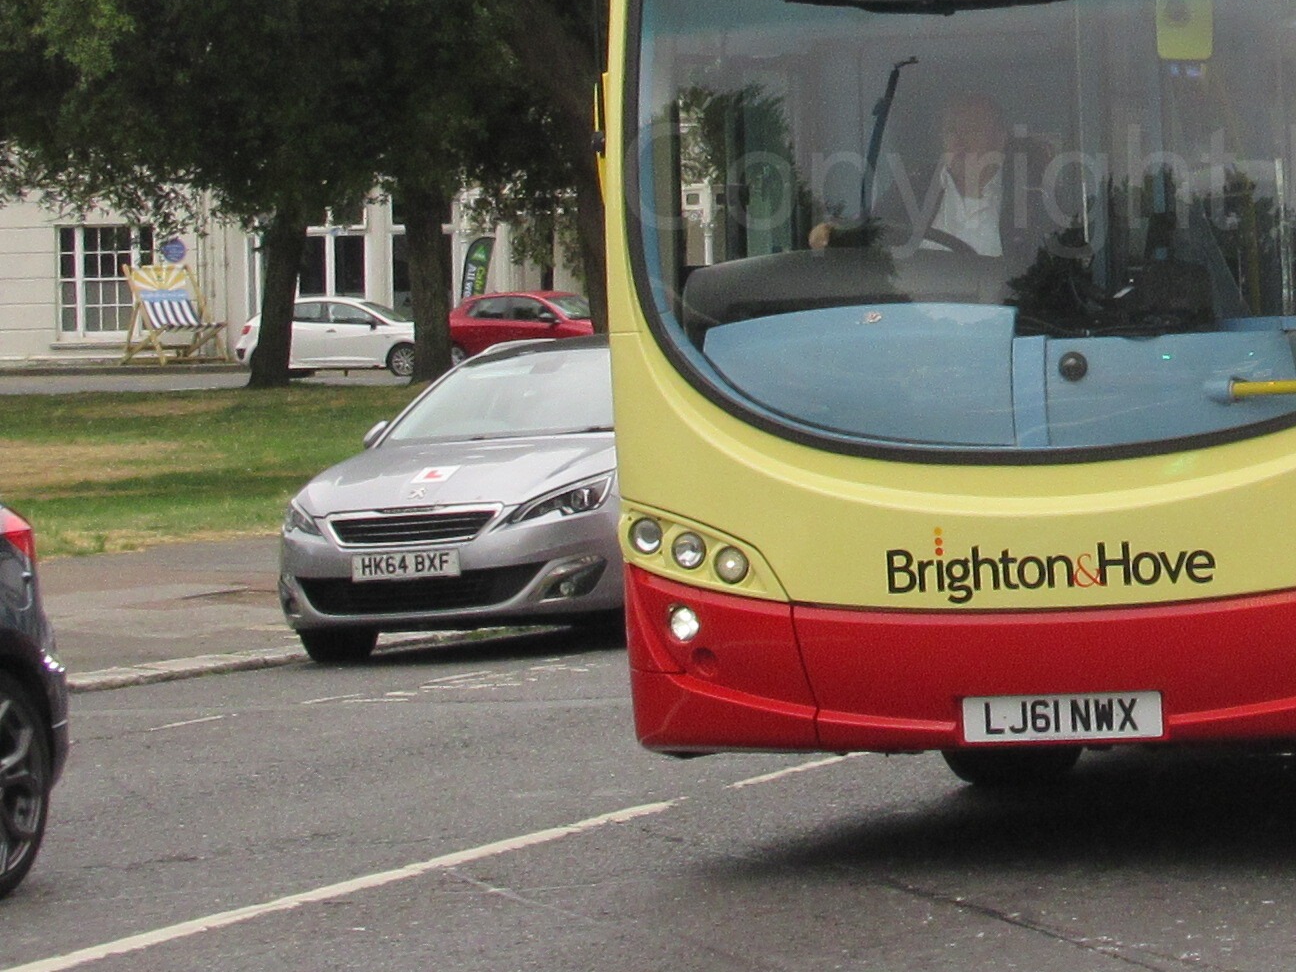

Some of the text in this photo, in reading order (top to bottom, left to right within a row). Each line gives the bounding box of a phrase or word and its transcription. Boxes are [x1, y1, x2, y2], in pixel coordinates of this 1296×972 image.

[361, 552, 450, 576] HK64 BXF
[886, 530, 1216, 604] Brighton&Hove
[984, 696, 1140, 736] LJ61 NWX
